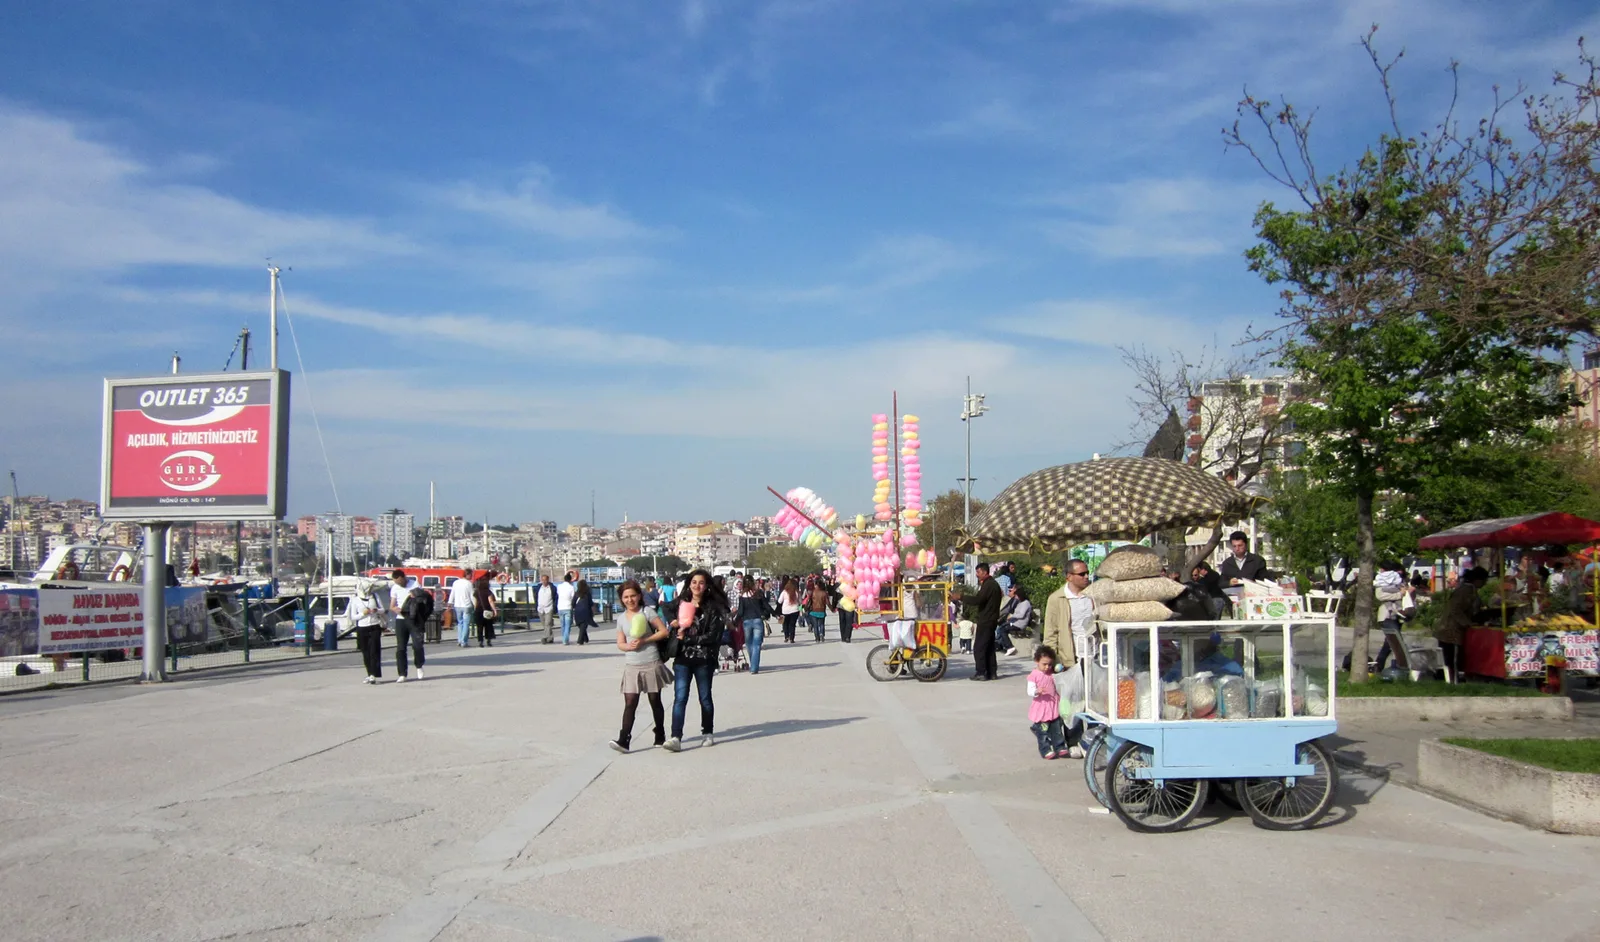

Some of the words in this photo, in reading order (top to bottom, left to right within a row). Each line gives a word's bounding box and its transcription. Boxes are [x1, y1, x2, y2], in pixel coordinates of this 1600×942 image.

[139, 388, 210, 407] OUTLET
[213, 387, 249, 404] 365
[127, 432, 169, 448] AÇILDIK,
[172, 428, 258, 445] HİZMETİNİZDEYİZ
[164, 463, 217, 474] GÜREL
[1566, 648, 1593, 656] MILK
